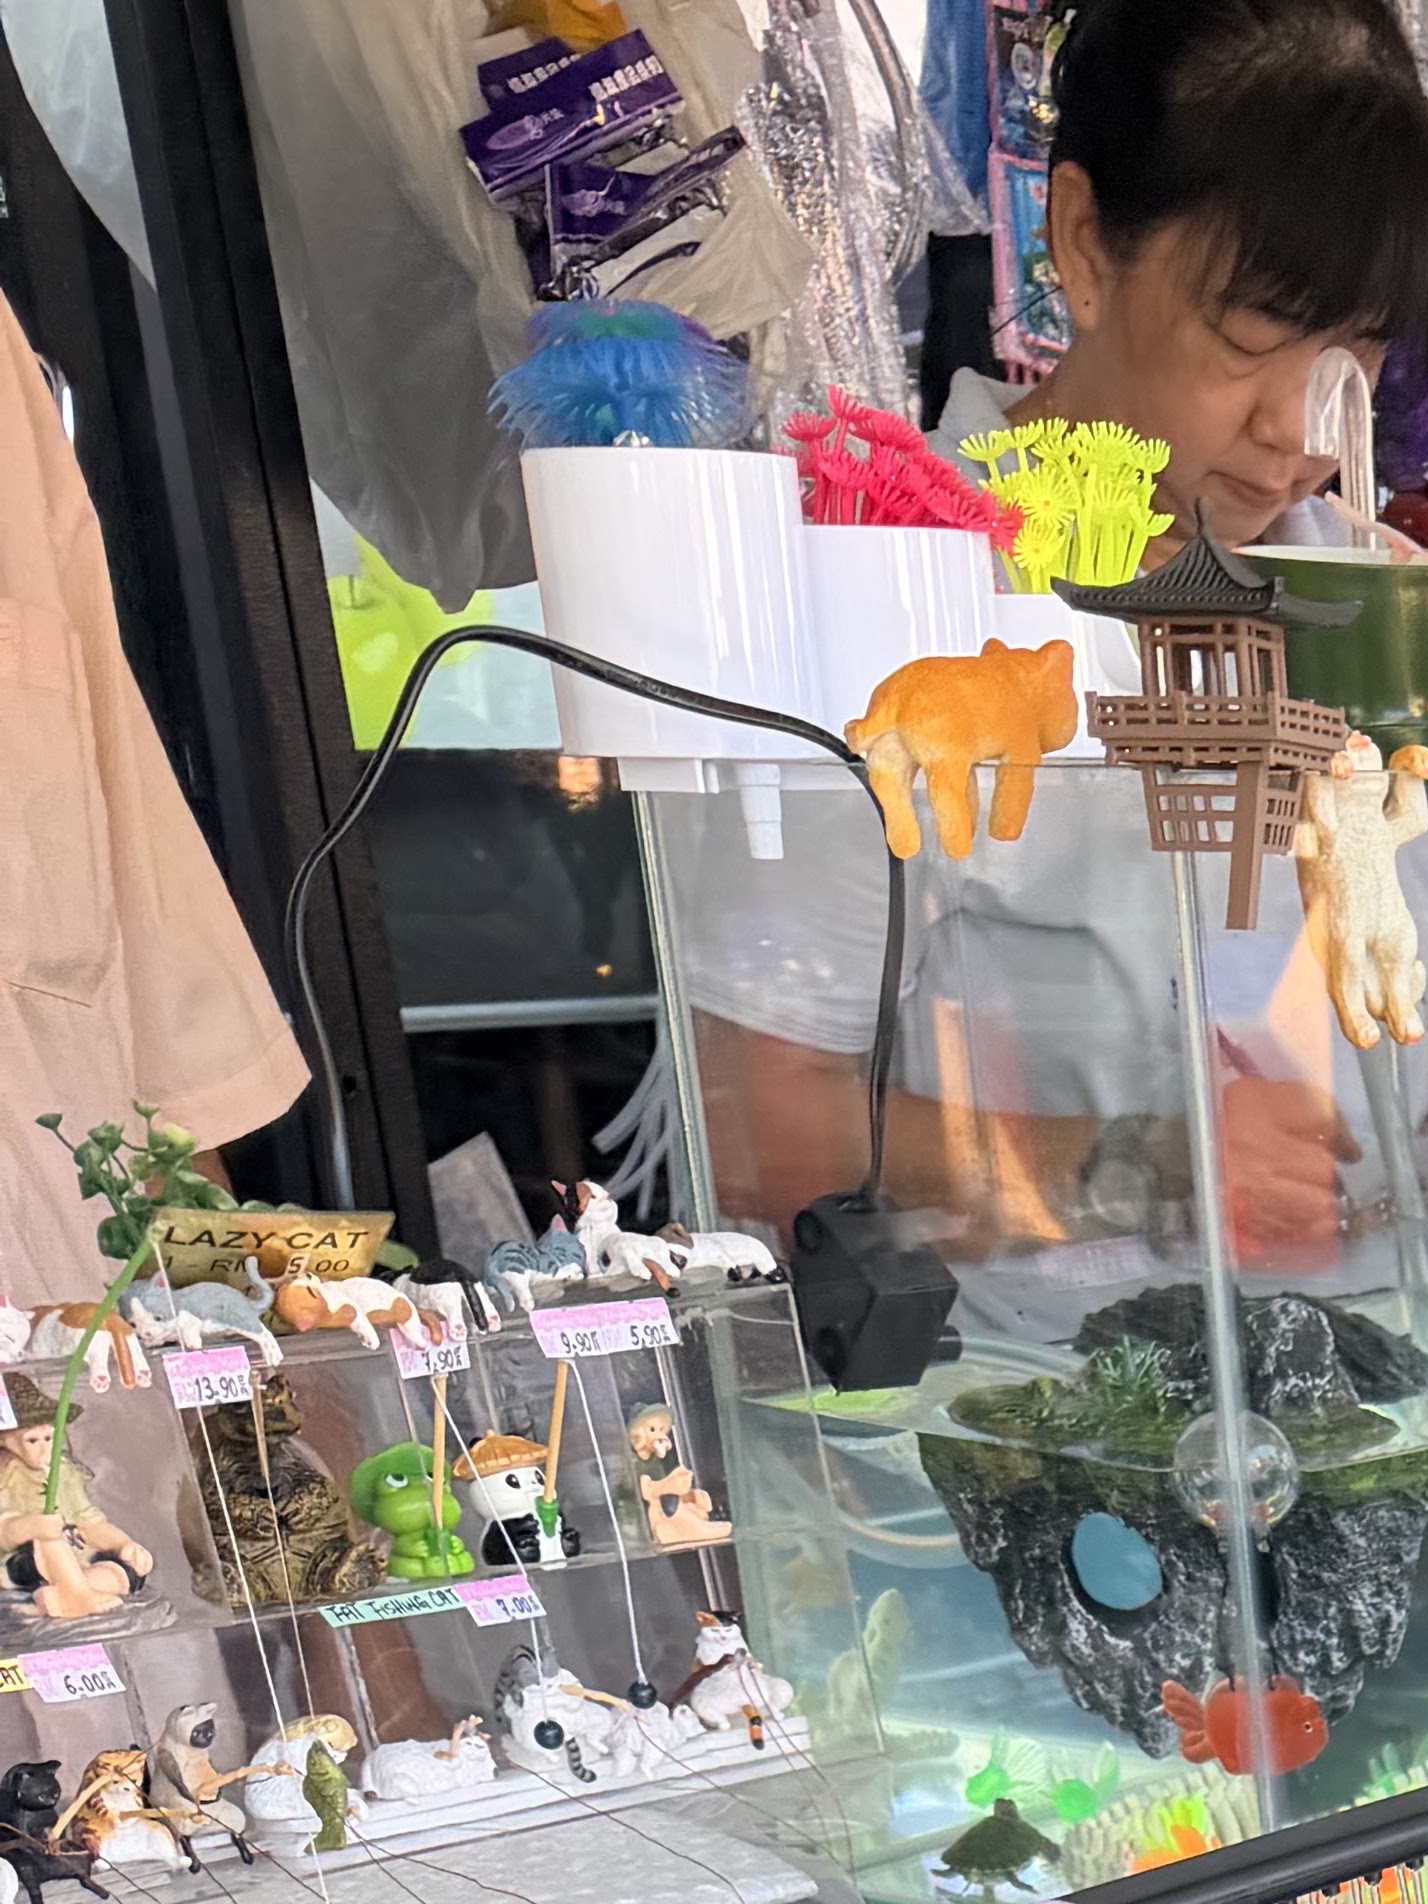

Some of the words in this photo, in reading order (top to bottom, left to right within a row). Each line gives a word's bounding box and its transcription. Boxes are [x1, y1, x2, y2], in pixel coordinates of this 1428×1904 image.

[164, 1227, 278, 1249] LAZY
[286, 1231, 369, 1249] CAT
[194, 1376, 238, 1401] 13.90
[63, 1673, 105, 1695] 6.00
